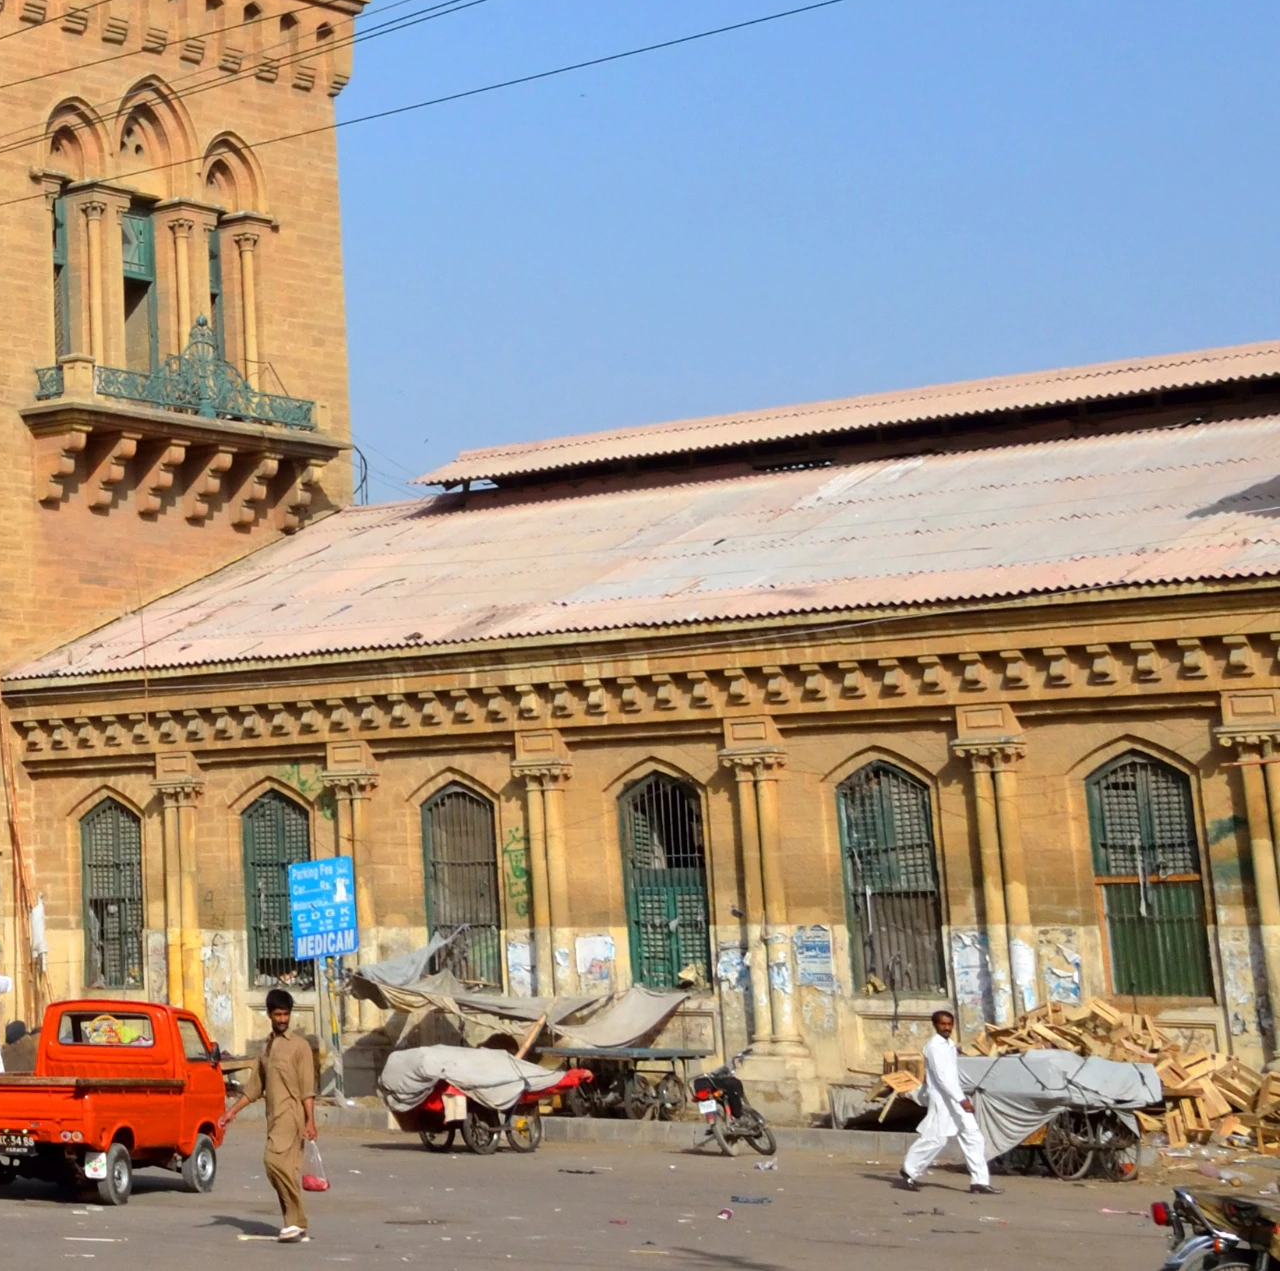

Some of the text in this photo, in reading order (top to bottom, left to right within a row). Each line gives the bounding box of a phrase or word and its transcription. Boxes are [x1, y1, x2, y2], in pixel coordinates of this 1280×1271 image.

[292, 864, 333, 881] Parking Fee
[297, 929, 354, 958] MEDICAM
